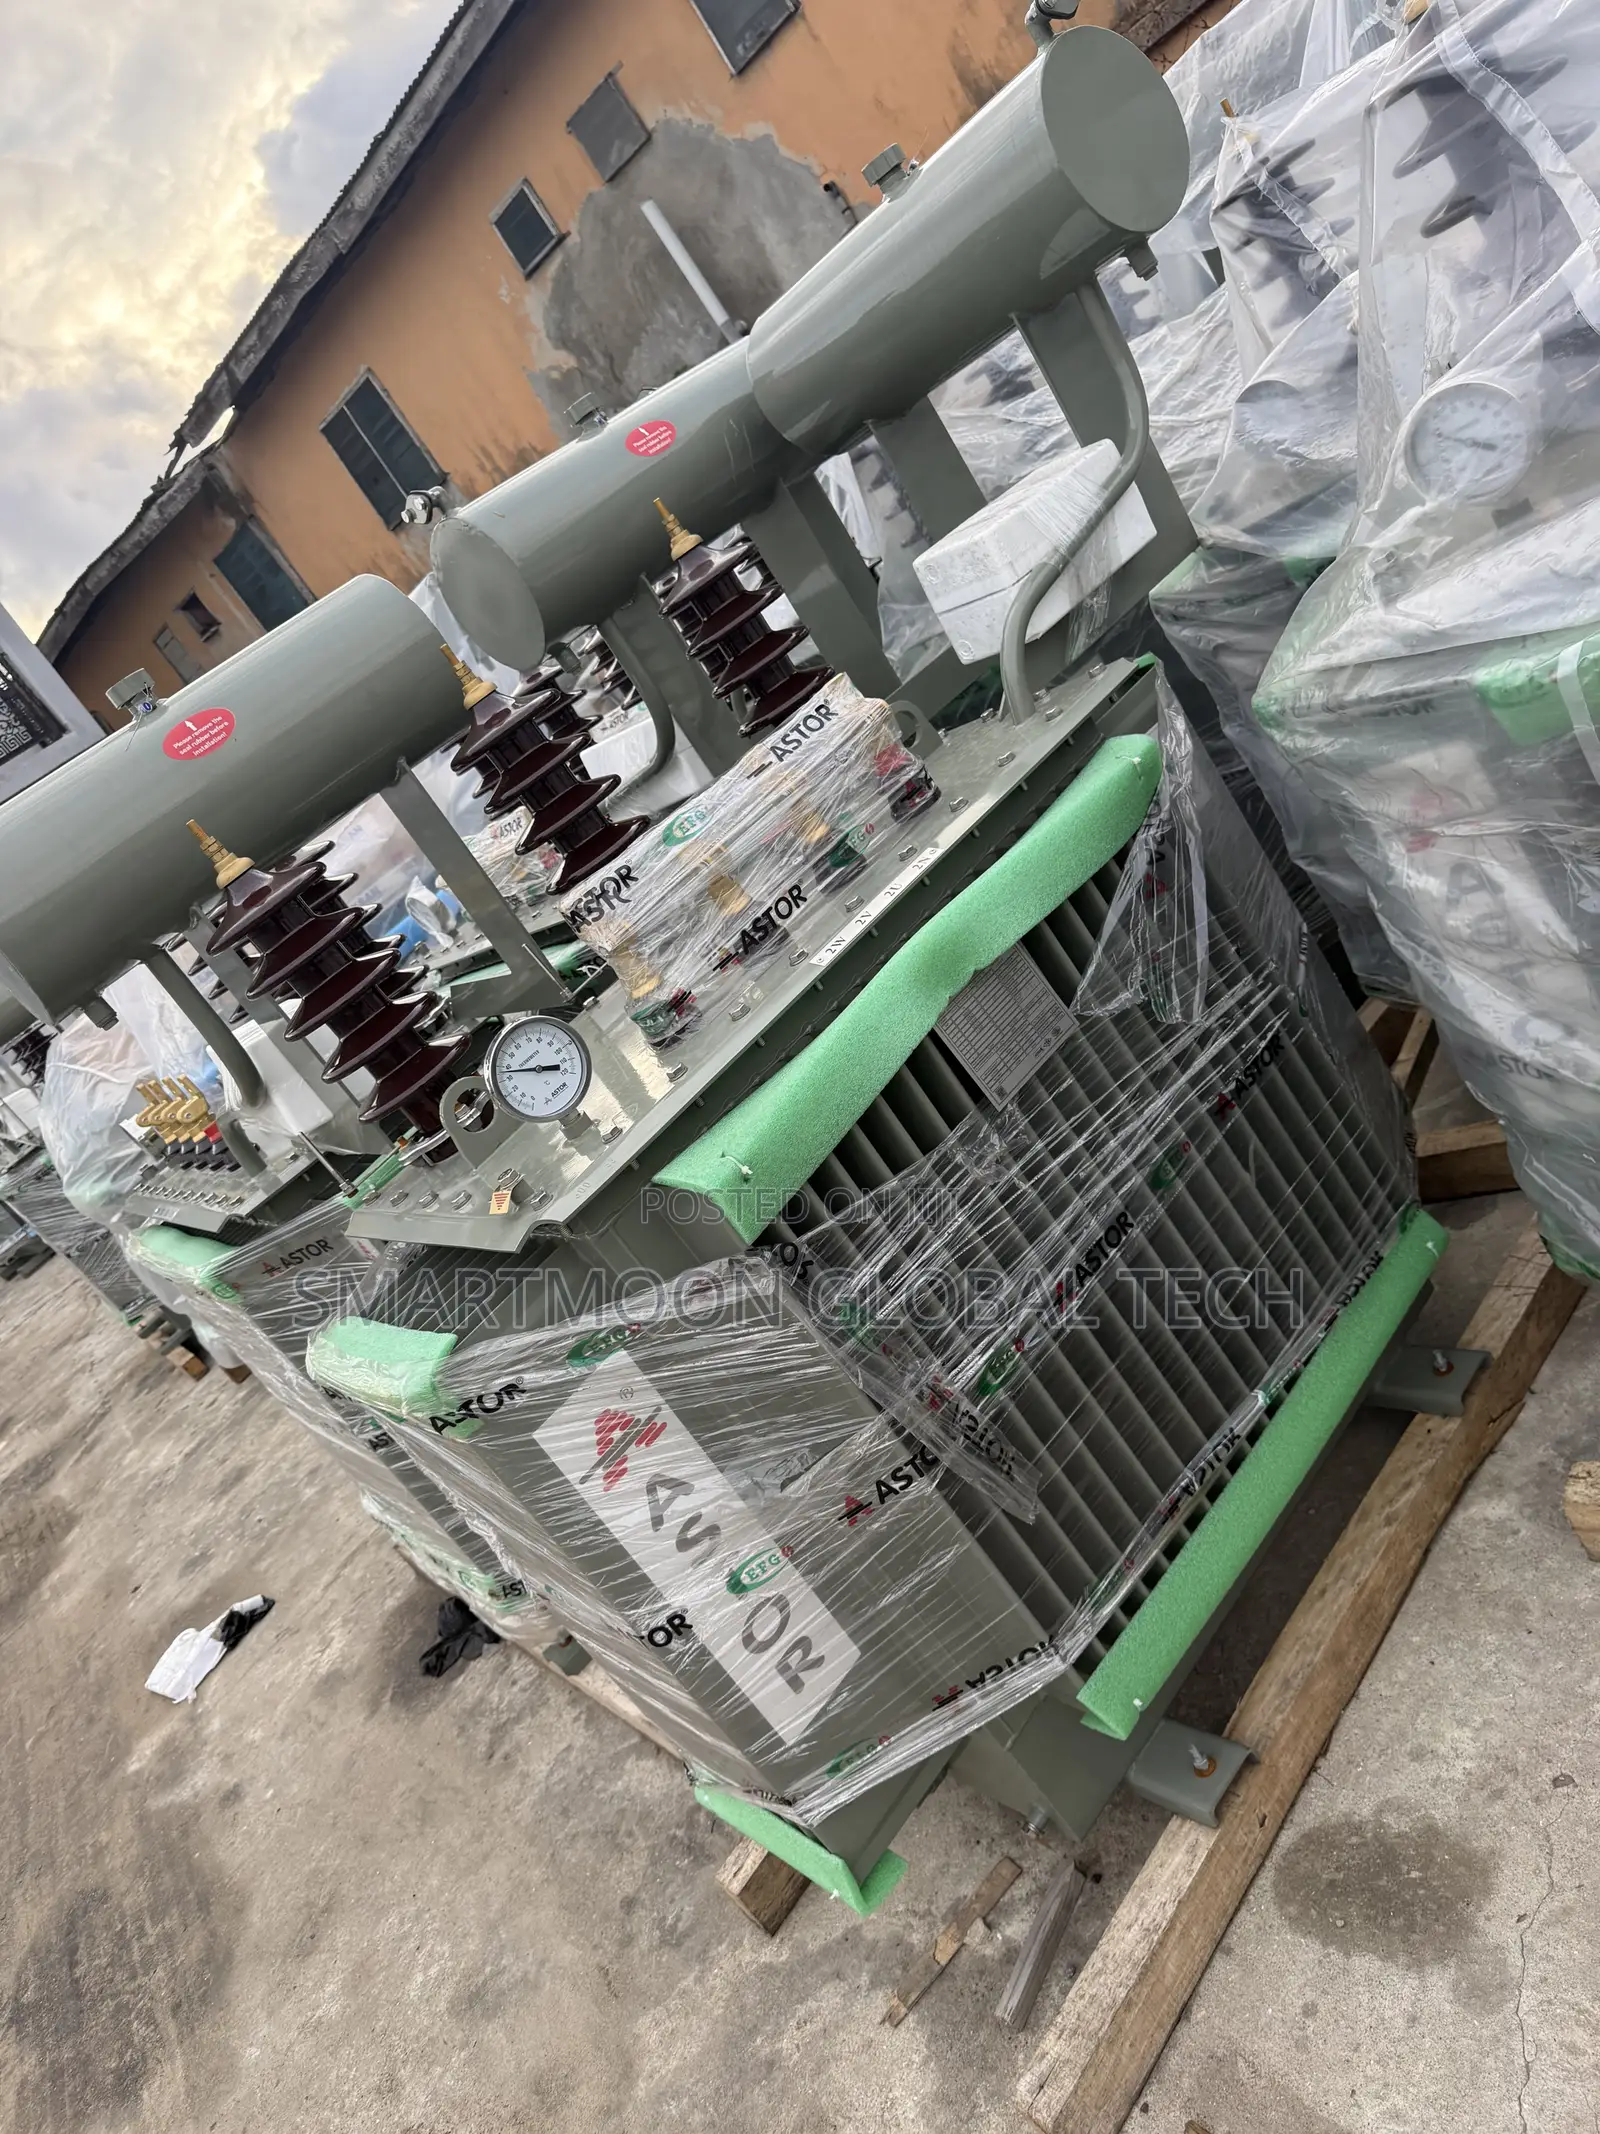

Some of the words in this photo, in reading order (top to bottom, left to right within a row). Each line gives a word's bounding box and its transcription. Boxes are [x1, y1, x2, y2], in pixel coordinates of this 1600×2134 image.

[172, 735, 193, 749] Please
[191, 722, 213, 738] remove
[211, 716, 223, 725] the
[179, 744, 192, 755] seal
[191, 733, 210, 748] rubber
[209, 721, 230, 735] before
[740, 884, 808, 955] ASTOR
[825, 936, 847, 954] 2W
[854, 910, 873, 926] 2V
[883, 883, 904, 897] 2U
[911, 857, 931, 870] 2N
[508, 1051, 516, 1060] 50
[554, 1046, 563, 1056] 100
[506, 1074, 513, 1083] 30
[560, 1067, 569, 1077] 120
[511, 1084, 519, 1093] 20
[551, 1081, 569, 1098] ASTOR
[279, 1238, 334, 1270] ASTOR
[1075, 1210, 1135, 1287] ASTOR
[744, 1554, 781, 1582] EFG
[645, 1473, 825, 1694] ASOR
